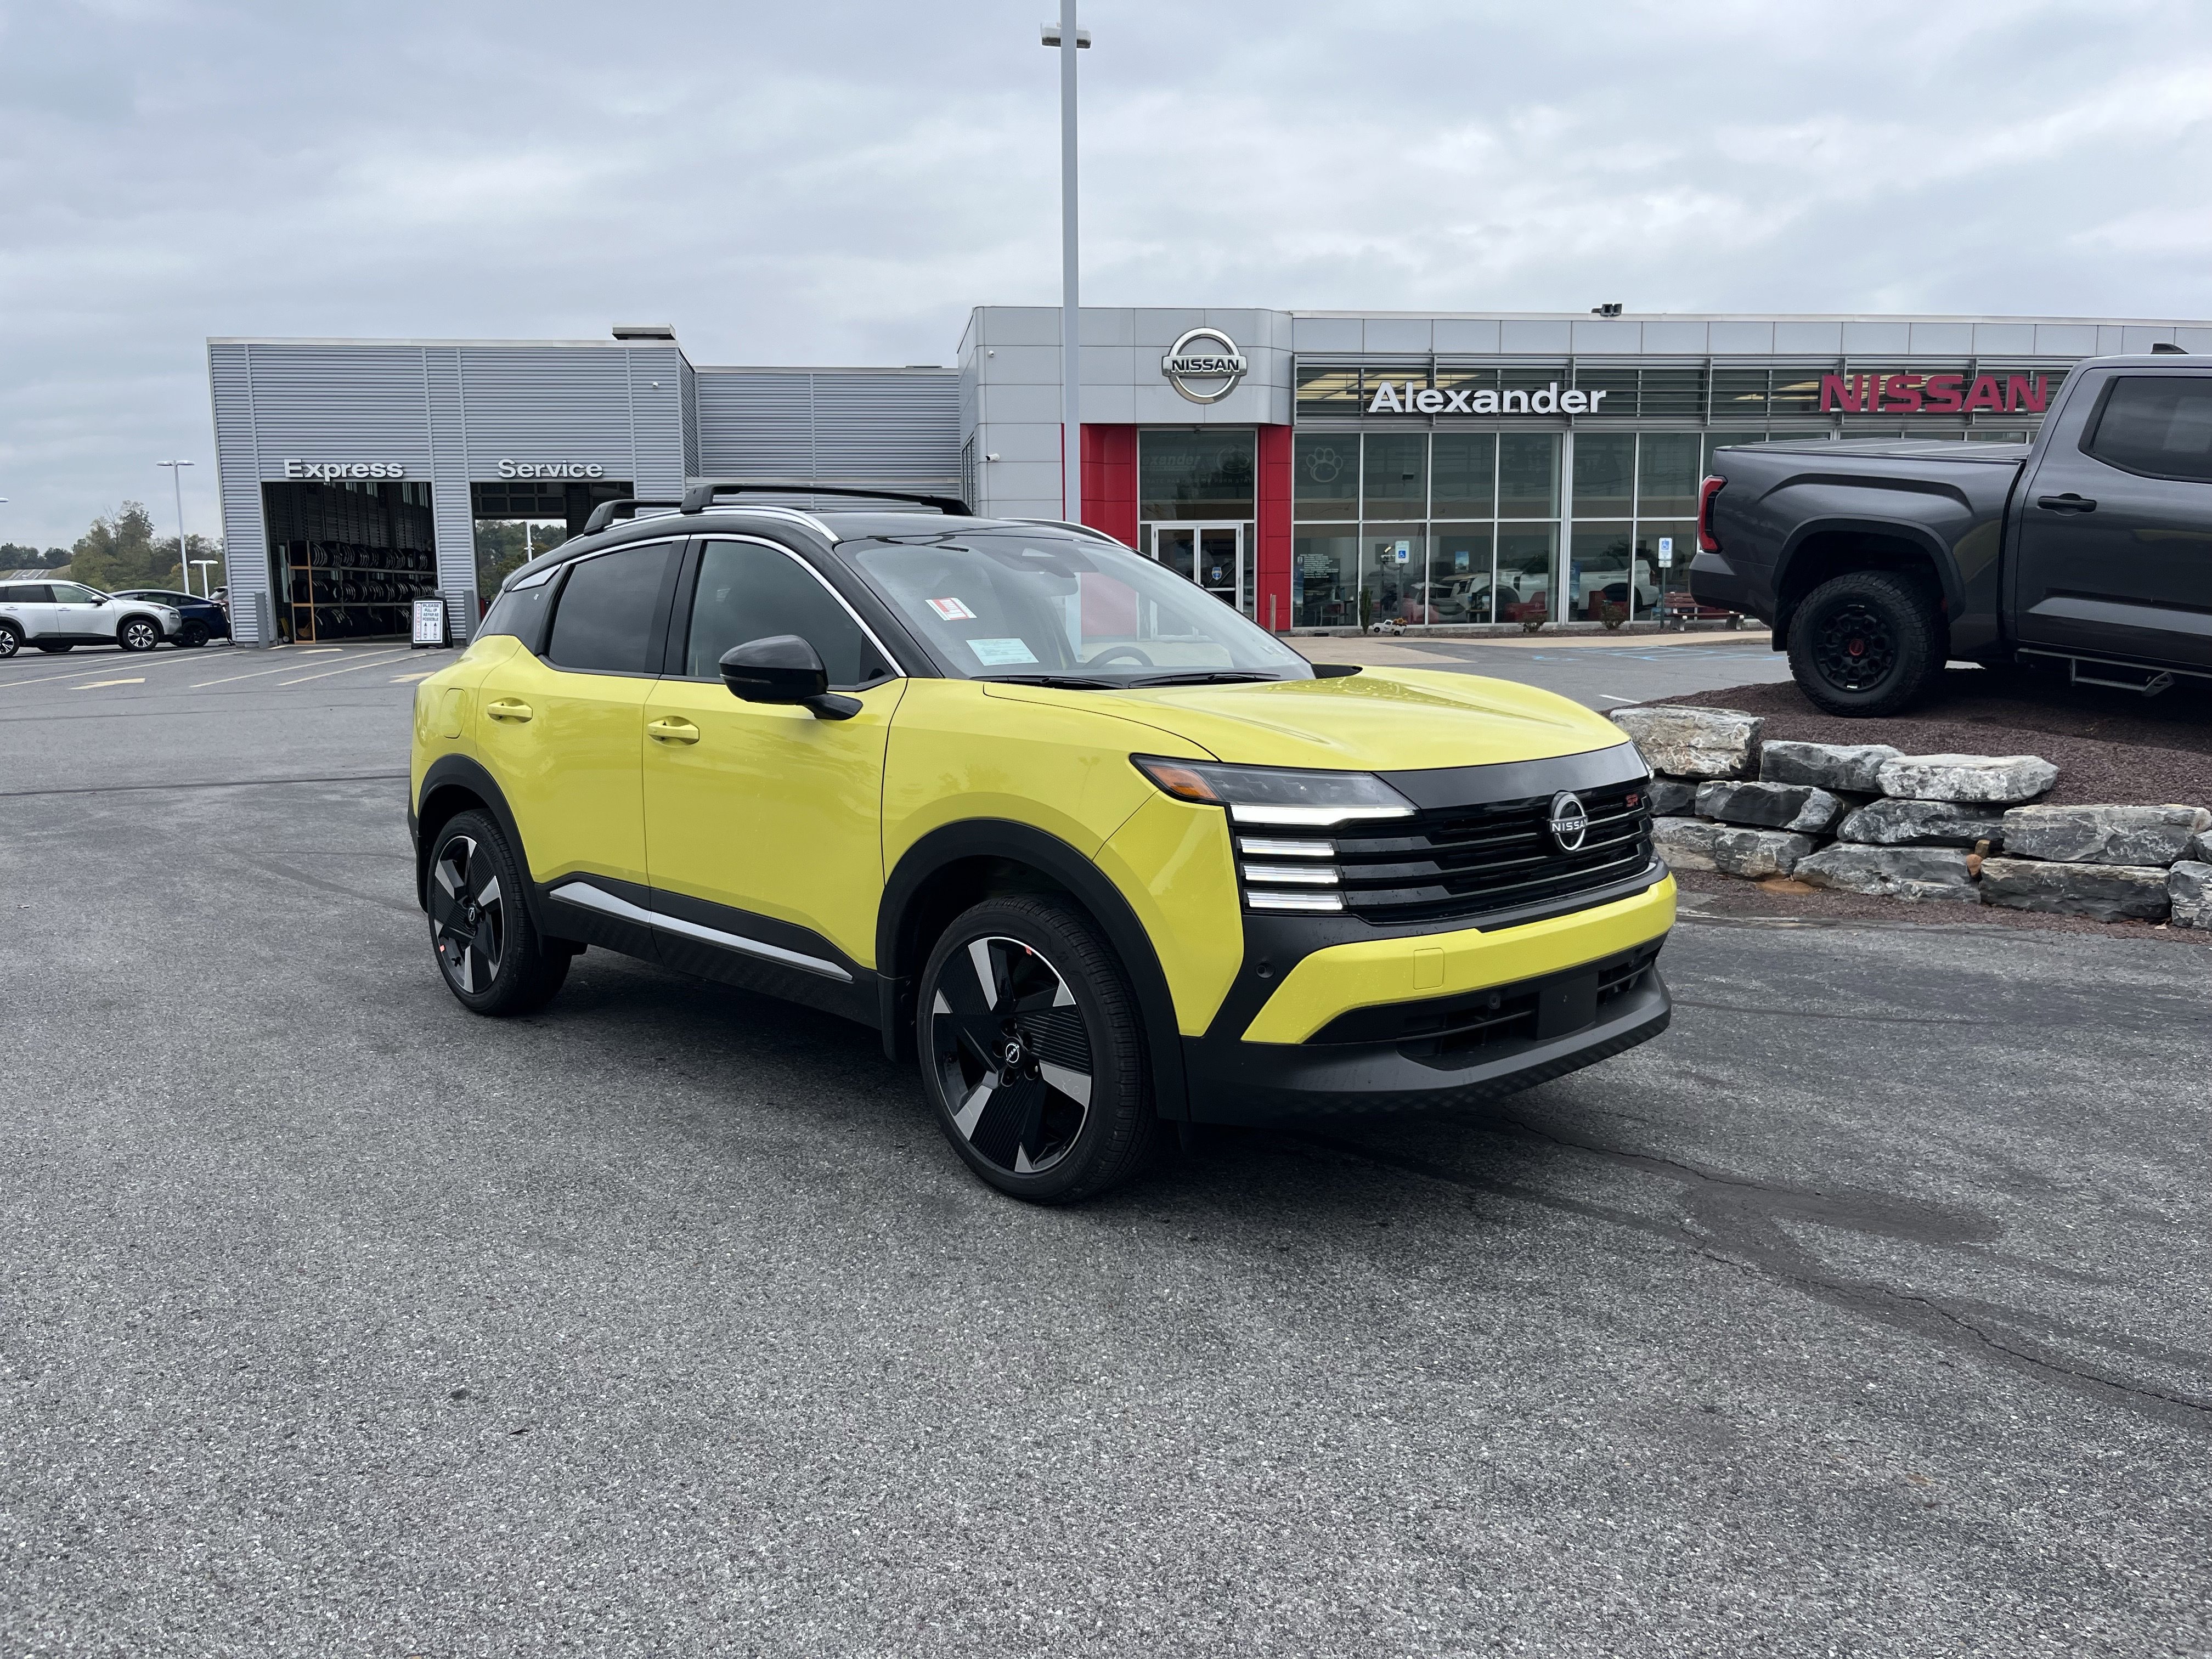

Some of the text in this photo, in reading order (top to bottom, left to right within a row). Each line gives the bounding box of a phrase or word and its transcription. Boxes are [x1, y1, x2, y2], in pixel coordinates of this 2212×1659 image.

[1171, 358, 1240, 373] NISSAN
[1368, 381, 1606, 414] Alexander
[1820, 374, 2047, 413] NISSAN
[284, 459, 404, 482] Express
[498, 459, 603, 478] Service
[1626, 794, 1638, 808] SR
[1551, 817, 1588, 832] NISSAN
